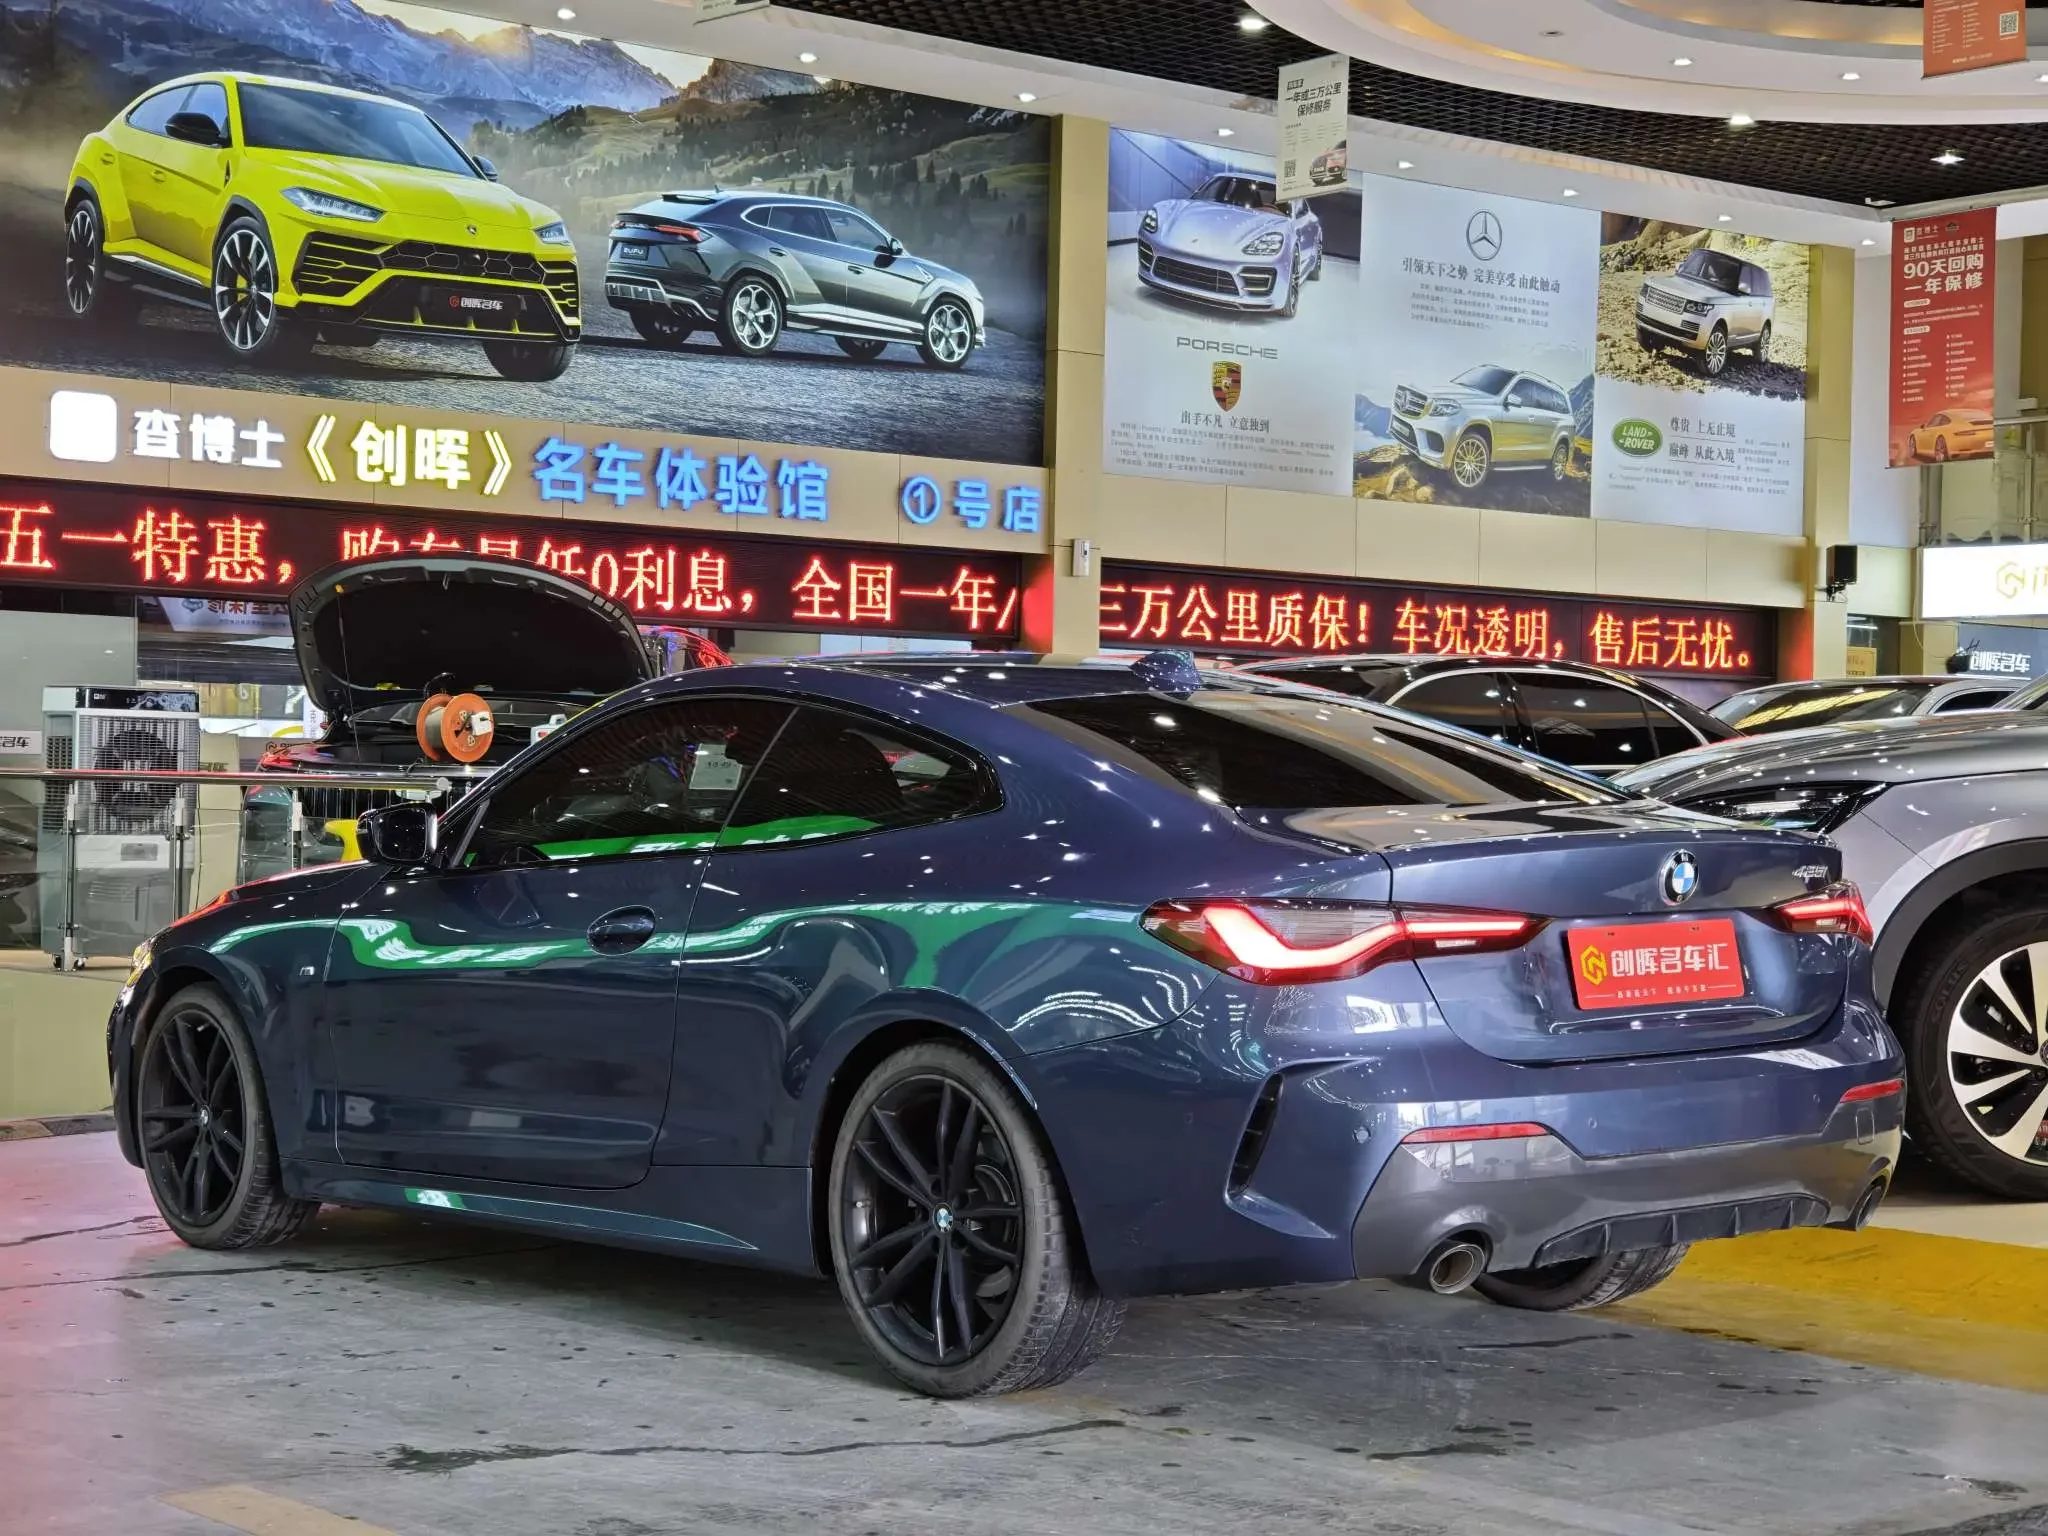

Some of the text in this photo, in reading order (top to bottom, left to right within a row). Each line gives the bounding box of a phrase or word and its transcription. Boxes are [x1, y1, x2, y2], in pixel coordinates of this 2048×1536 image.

[1402, 257, 1561, 294] 引领天下之势 完美享受 由此触动
[1904, 253, 1984, 279] 90天回购
[1904, 271, 1984, 294] 一年保修
[1176, 336, 1278, 360] PORSCHE
[1181, 410, 1270, 433] 出手不凡 立意独到
[1622, 426, 1648, 437] LAND
[1670, 416, 1736, 438] 尊贵 上无止境
[1624, 437, 1655, 450] ROVER
[1695, 445, 1736, 463] 从此入境
[132, 409, 1042, 533] 查博士 《创晖》 名车体验馆 ①号店
[1970, 651, 2031, 673] 创晖名车
[0, 736, 31, 747] 名车
[1611, 943, 1729, 977] 创晖名车汇
